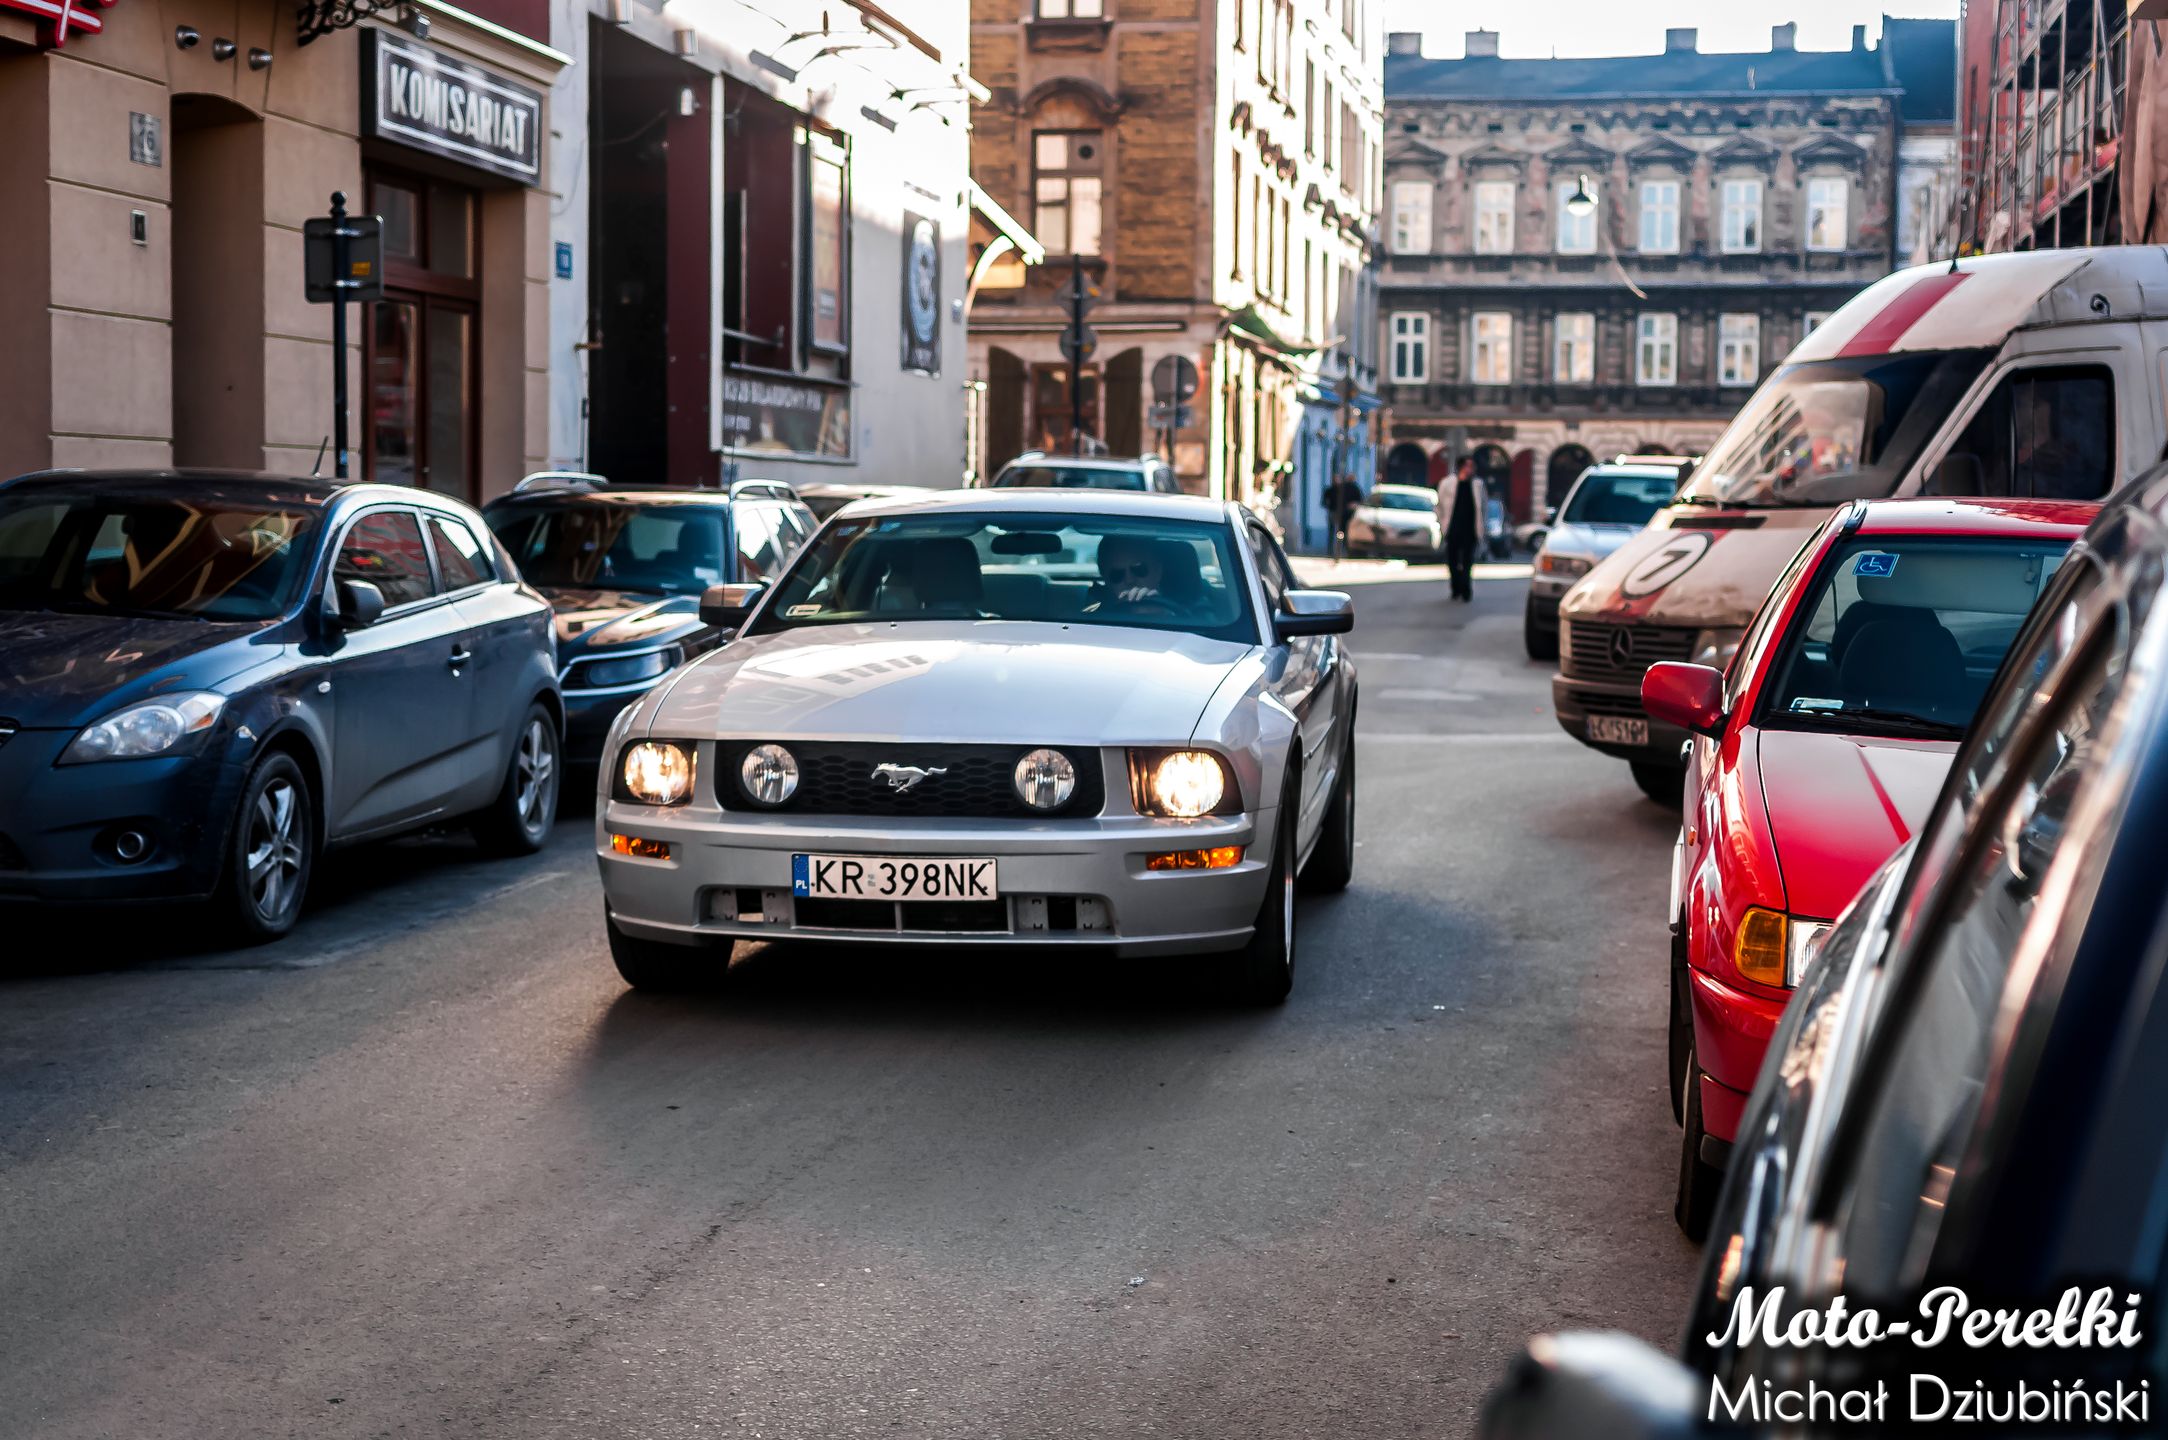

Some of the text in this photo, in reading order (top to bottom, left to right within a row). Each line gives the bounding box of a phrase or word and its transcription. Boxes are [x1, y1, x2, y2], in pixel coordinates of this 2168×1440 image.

[389, 63, 529, 155] KOMISARIAT
[1637, 549, 1693, 582] 7
[795, 880, 807, 890] PL
[815, 860, 991, 897] KR 398NK
